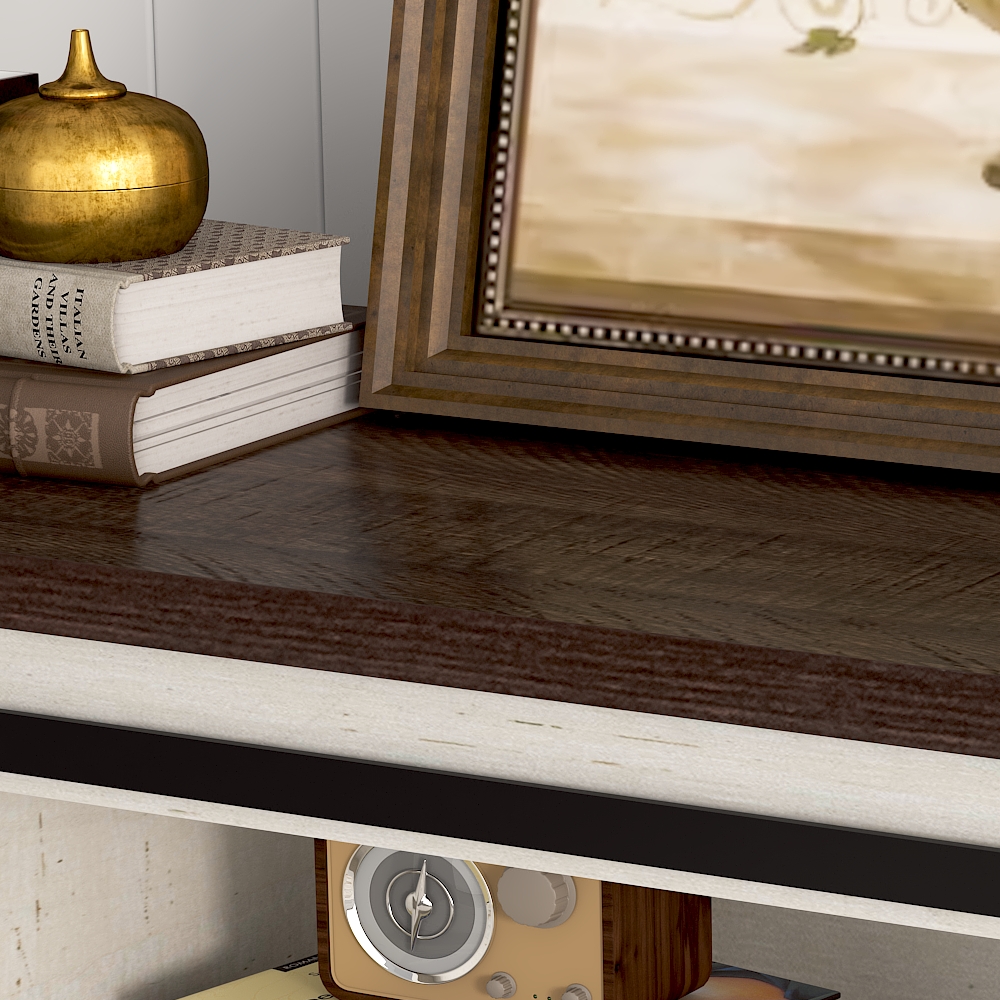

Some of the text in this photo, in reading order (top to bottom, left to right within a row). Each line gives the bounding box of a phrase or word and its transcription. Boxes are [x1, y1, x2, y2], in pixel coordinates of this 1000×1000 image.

[31, 277, 47, 358] GARDENS
[45, 273, 63, 365] AND THEIR
[59, 291, 72, 354] VILLAS
[73, 288, 88, 360] ITALIAN
